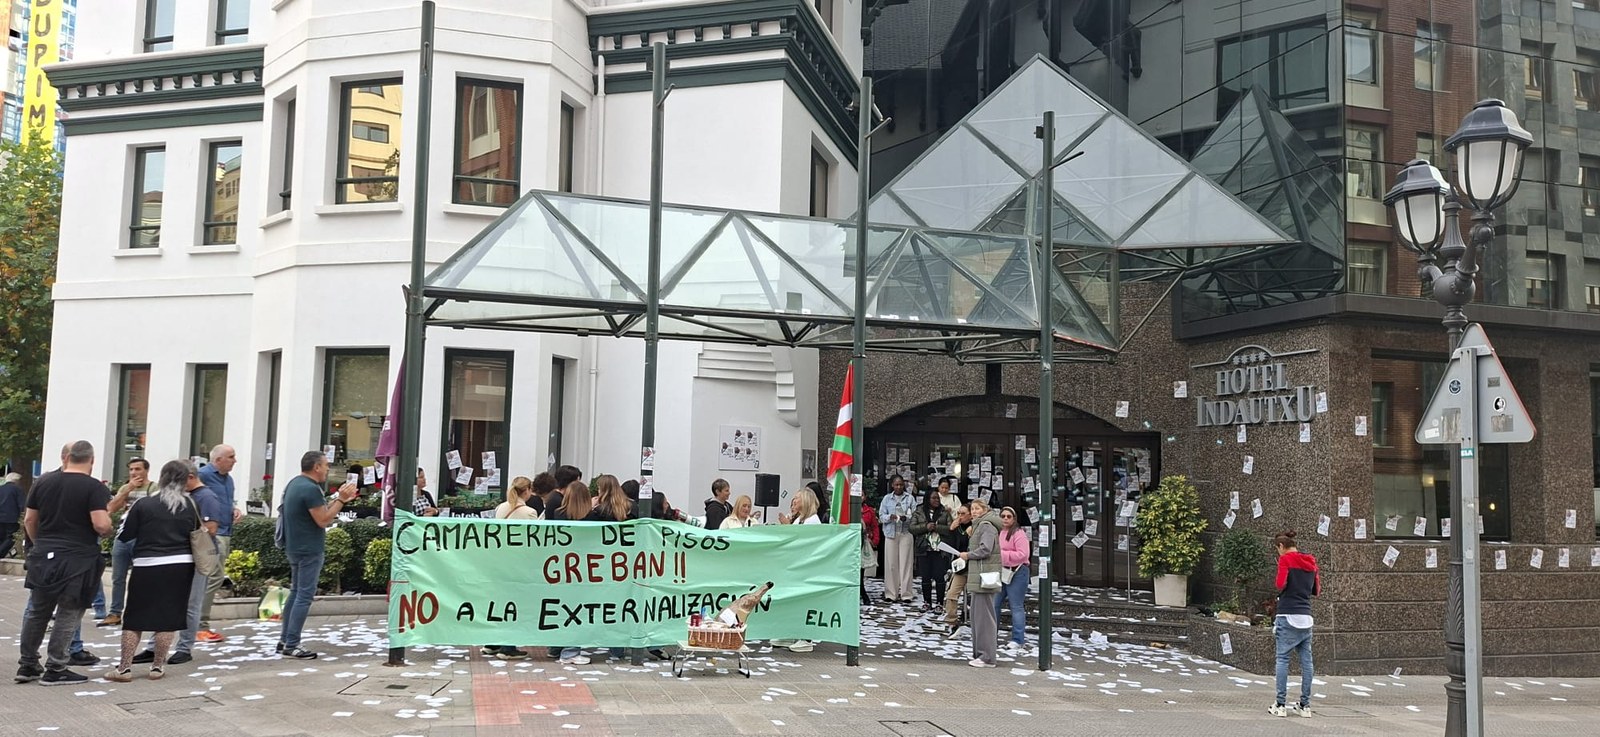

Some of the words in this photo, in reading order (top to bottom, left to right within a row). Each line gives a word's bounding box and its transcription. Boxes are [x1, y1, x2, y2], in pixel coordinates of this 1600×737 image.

[1216, 362, 1289, 395] HOTEL
[1195, 384, 1315, 427] INDAUTXU
[396, 521, 573, 556] CAMARERAS
[602, 524, 636, 547] DE
[662, 525, 731, 551] PISOS
[398, 590, 439, 633] NO
[457, 601, 475, 622] A
[487, 601, 518, 622] LA
[538, 585, 772, 631] EXTERNALIZACN
[805, 609, 842, 628] ELA
